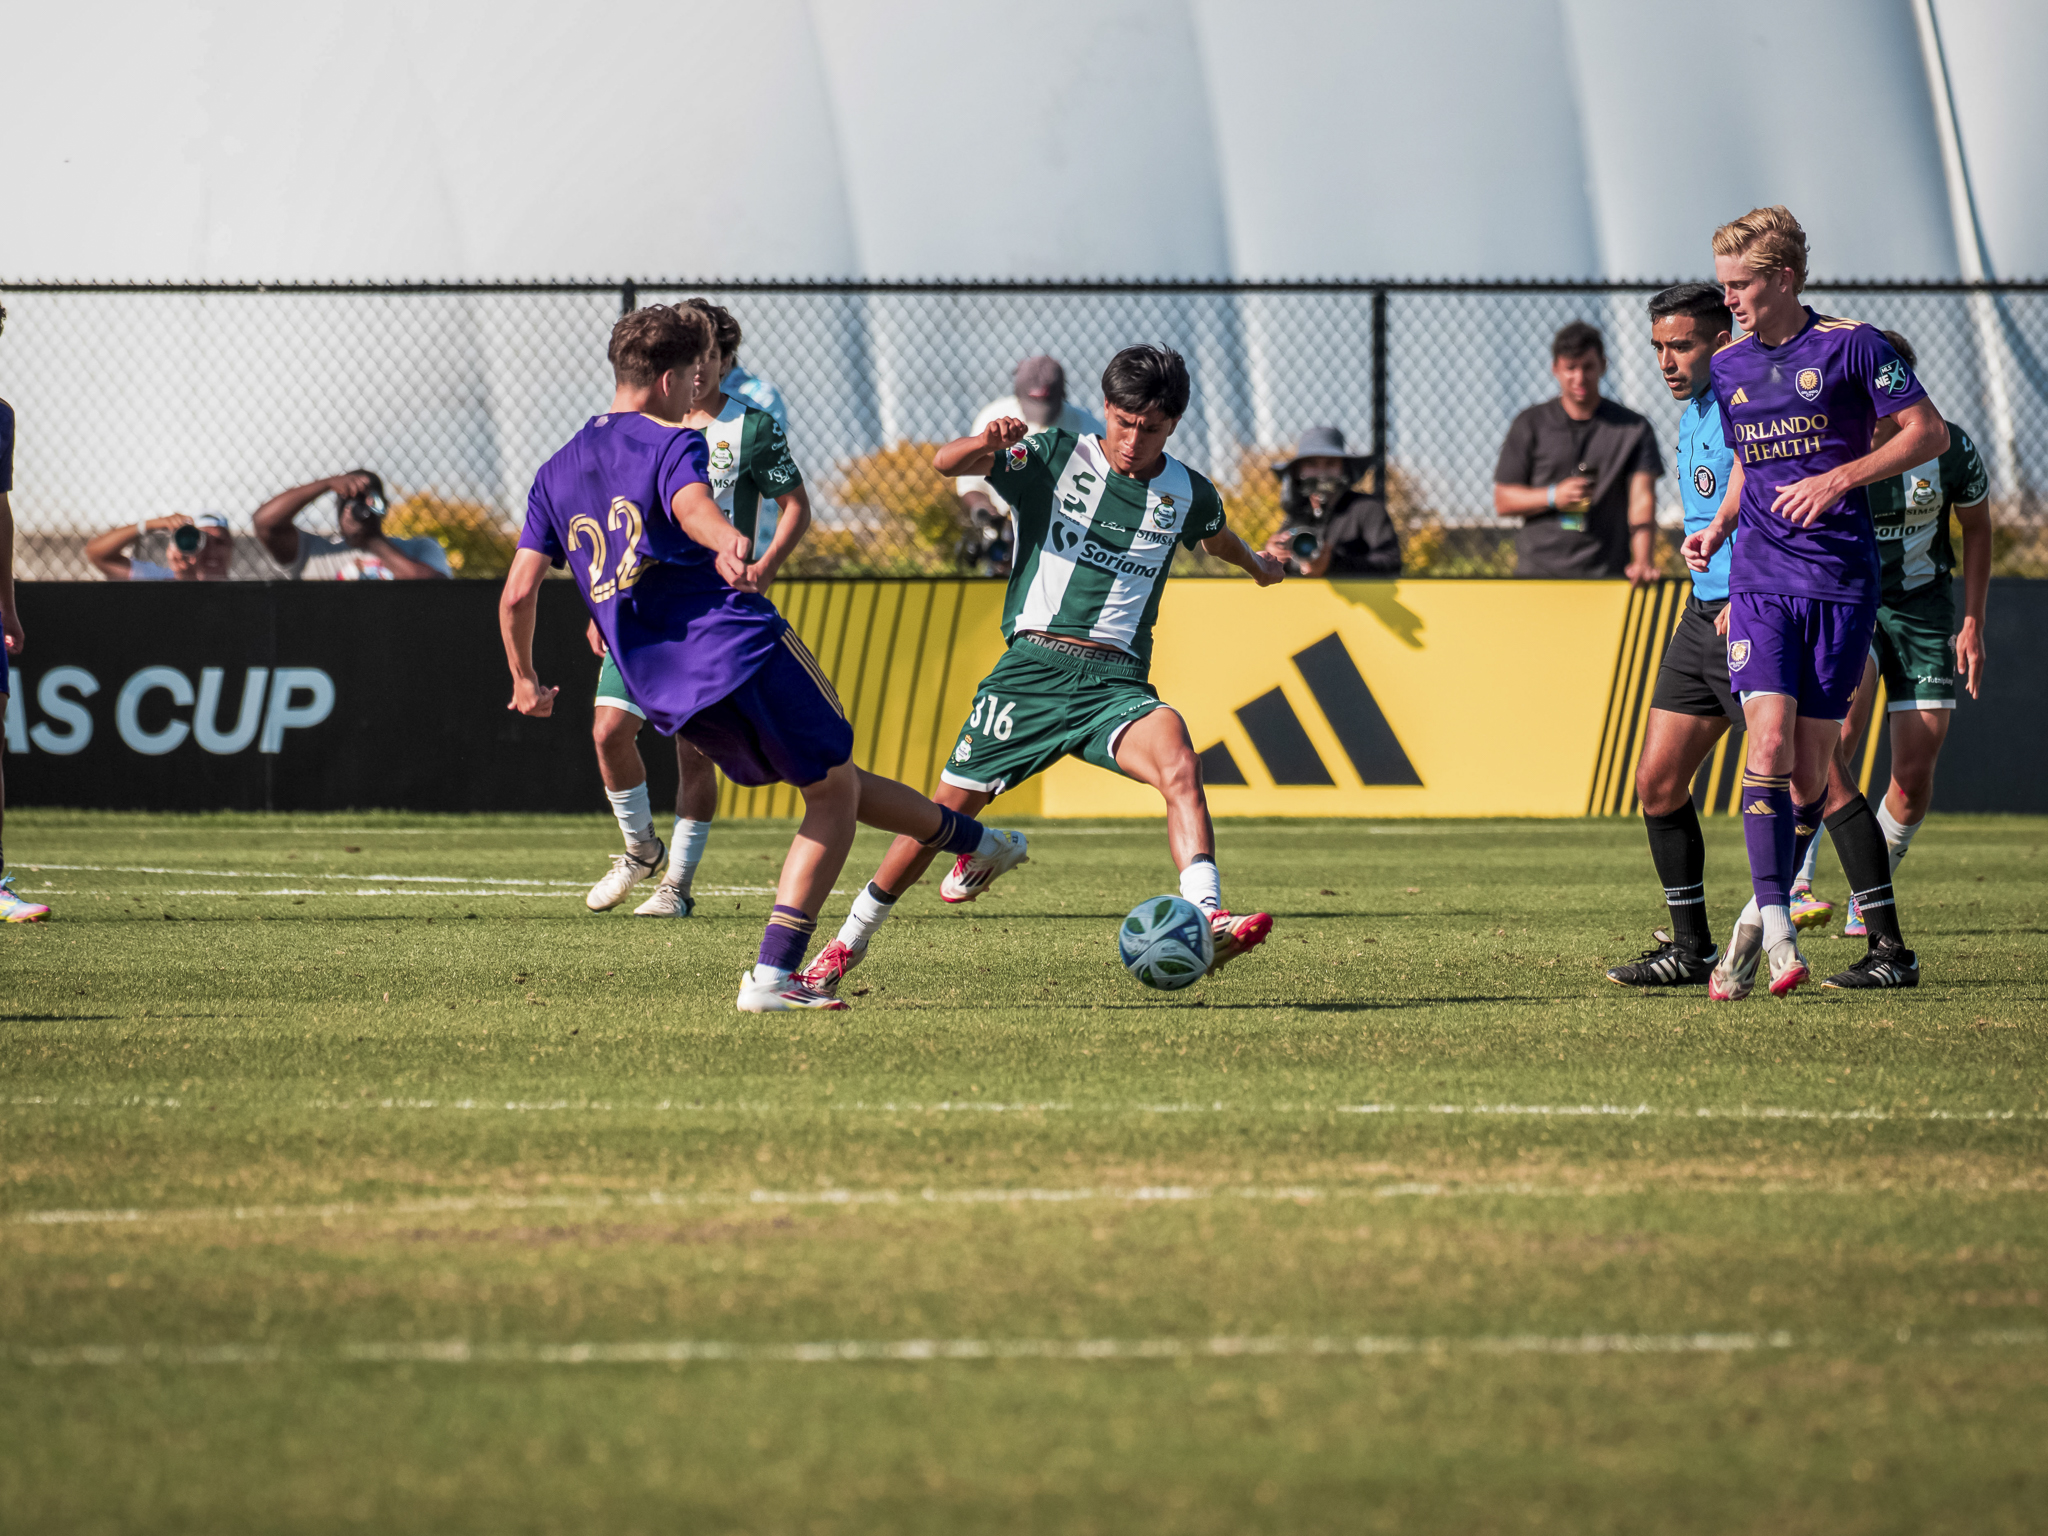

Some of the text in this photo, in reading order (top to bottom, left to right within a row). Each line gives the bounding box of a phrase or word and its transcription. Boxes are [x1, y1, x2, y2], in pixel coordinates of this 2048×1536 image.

[1881, 365, 1893, 374] MLS
[1734, 414, 1829, 443] ORLANDO
[1744, 435, 1823, 464] HEALTH
[568, 495, 658, 603] 22
[1136, 529, 1174, 547] SIMSA
[1080, 543, 1158, 579] Soriana
[114, 664, 336, 756] CUP
